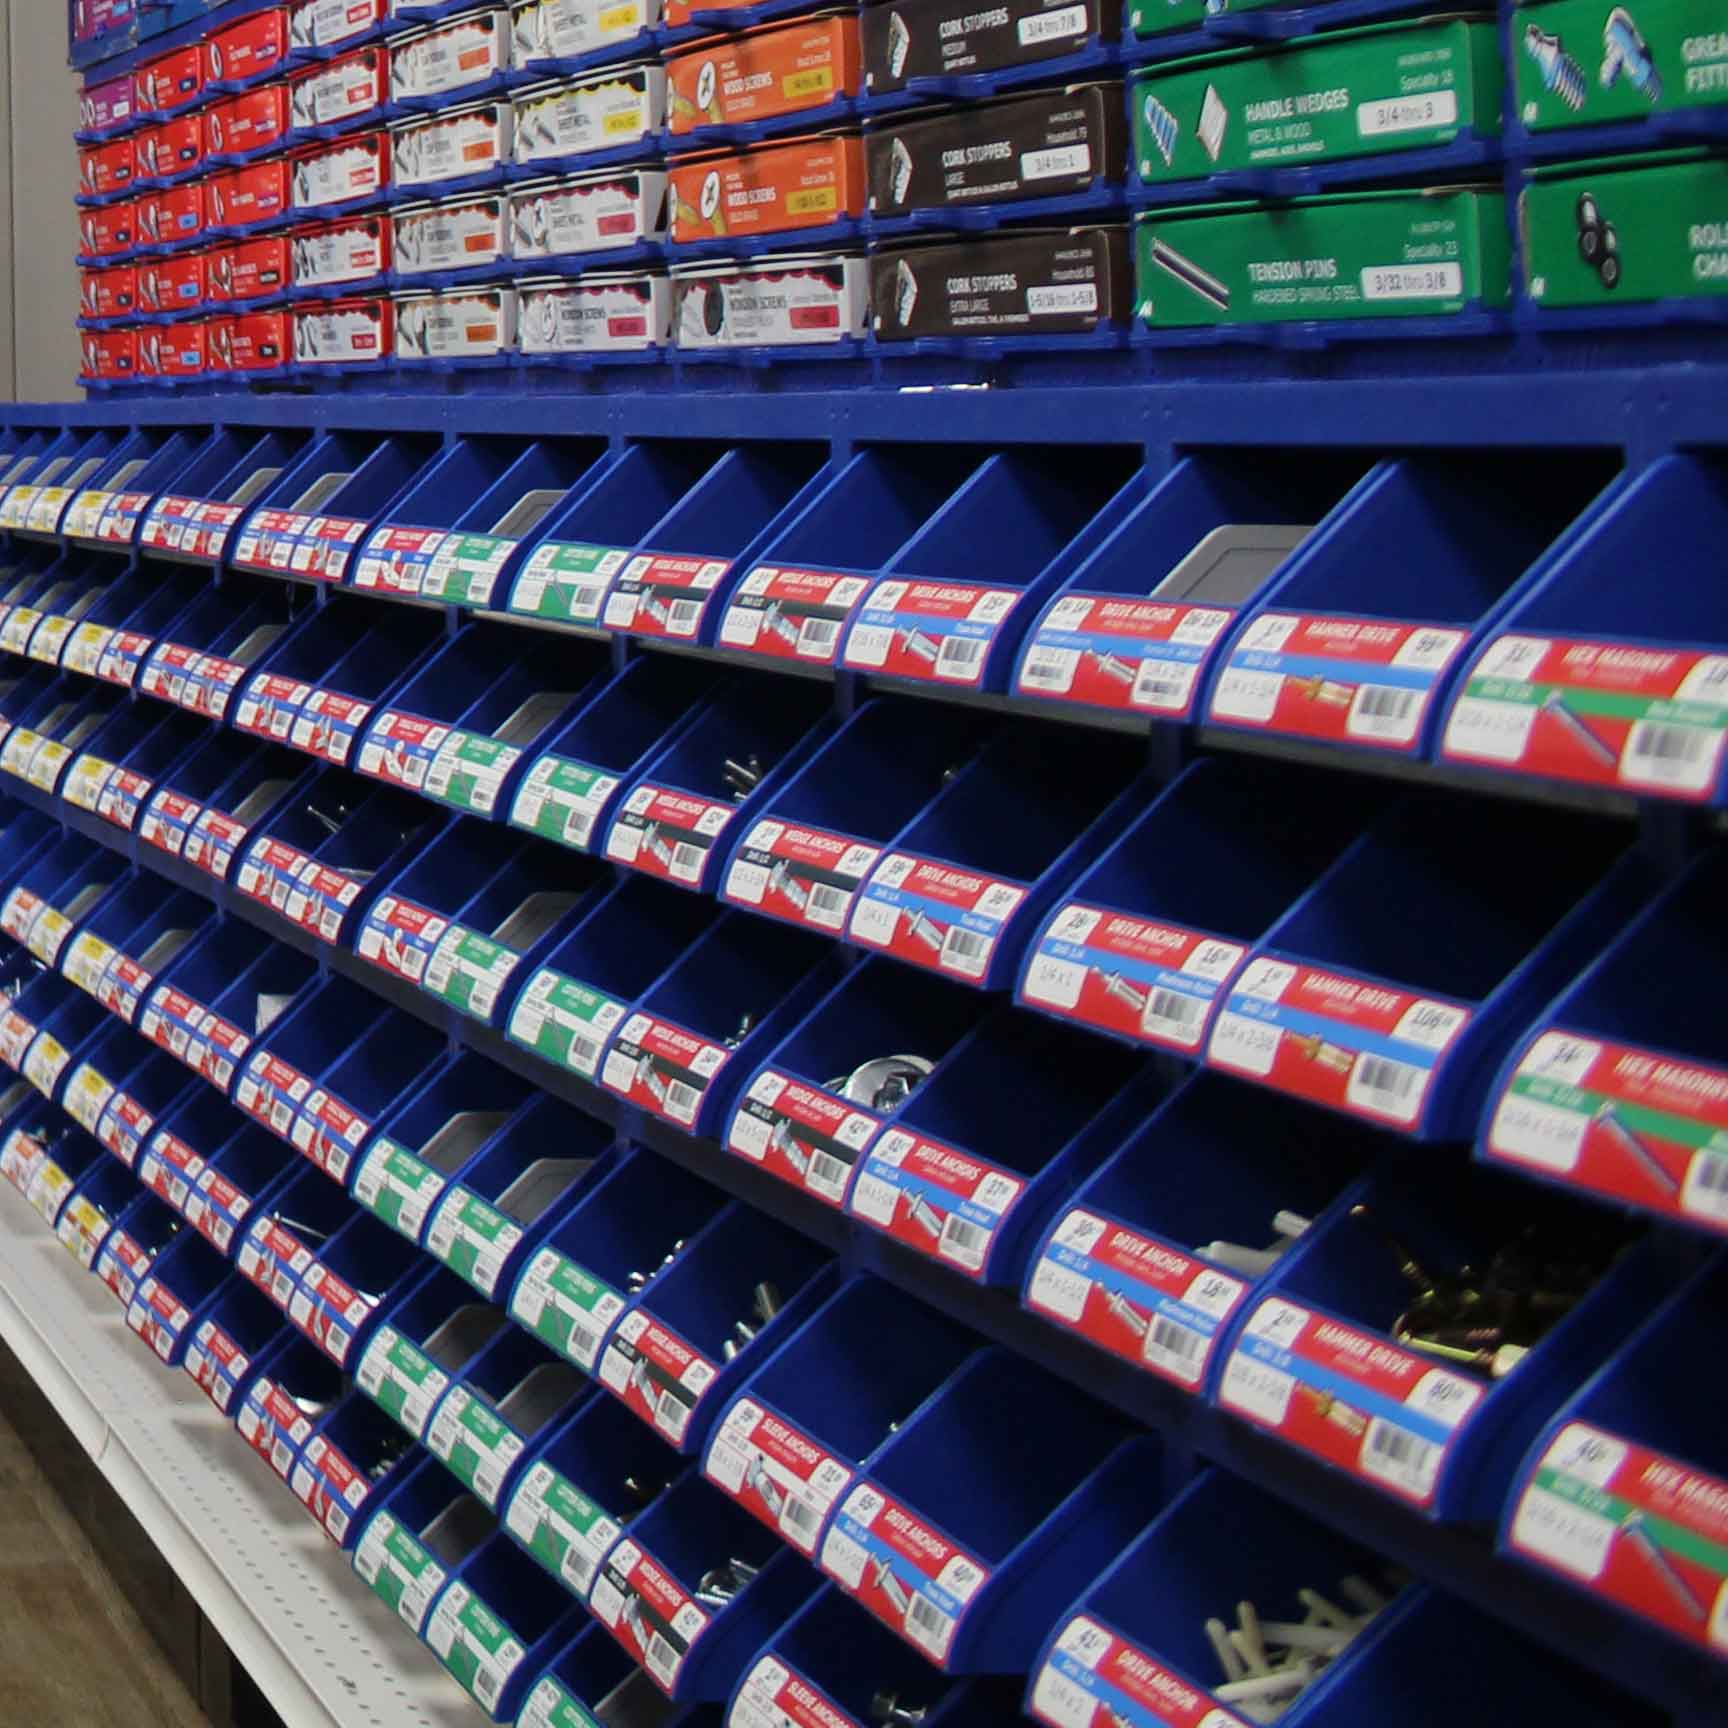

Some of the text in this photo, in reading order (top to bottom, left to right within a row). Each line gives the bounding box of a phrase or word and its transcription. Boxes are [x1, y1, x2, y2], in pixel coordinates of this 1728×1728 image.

[963, 7, 1009, 32] STOPPERS
[1245, 88, 1350, 122] HANDLE WEDGES
[965, 140, 1012, 164] STOPPERS
[1247, 257, 1337, 284] TENSION PINS
[947, 273, 1017, 294] CORK STOPPERS
